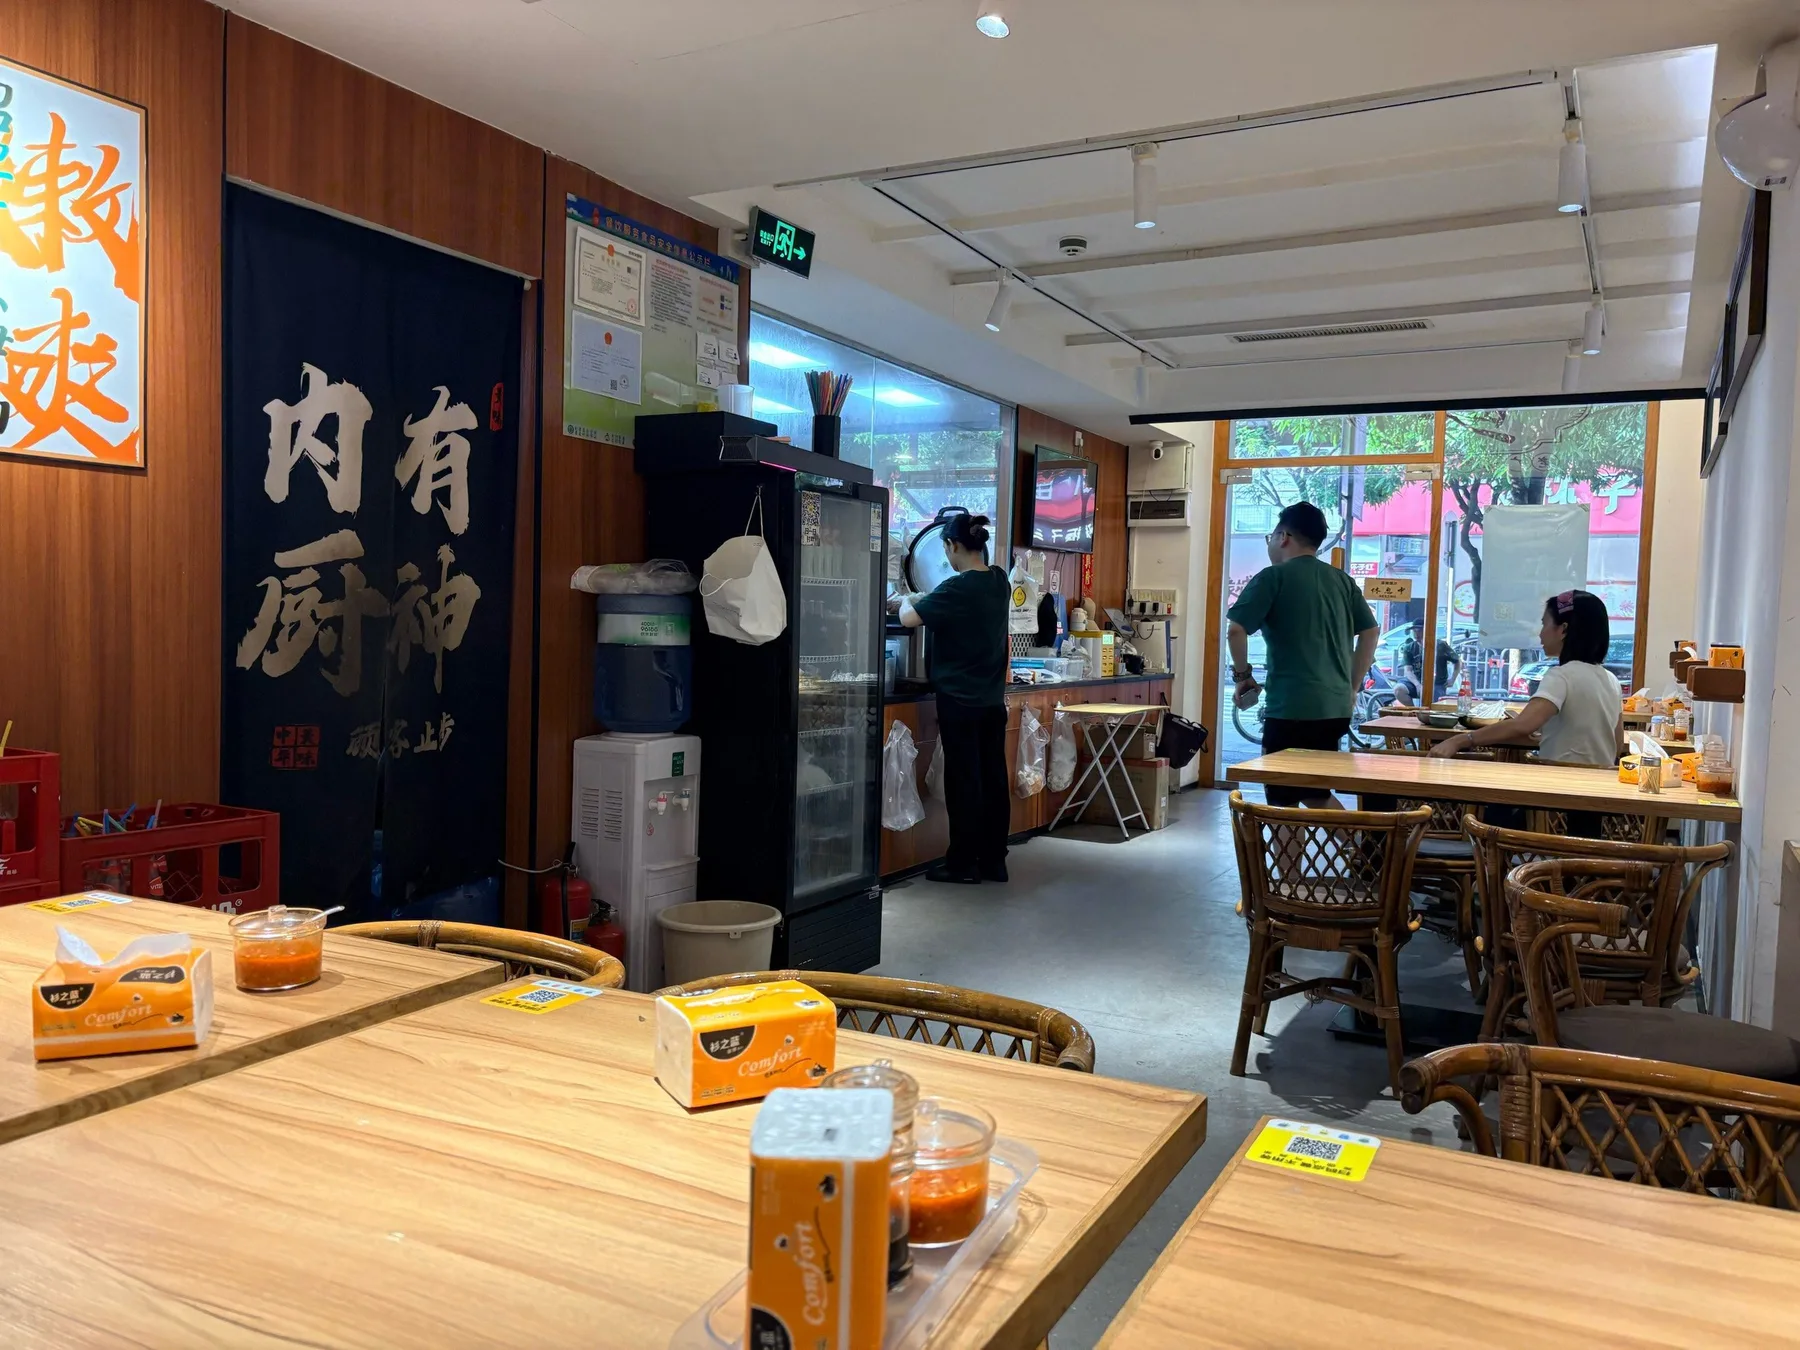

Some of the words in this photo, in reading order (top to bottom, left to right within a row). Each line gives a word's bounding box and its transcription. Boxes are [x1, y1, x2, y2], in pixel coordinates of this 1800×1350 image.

[760, 237, 772, 247] EXIT
[1370, 586, 1406, 595] 休息中
[84, 1004, 153, 1027] Comfort
[738, 1047, 804, 1077] Comfort
[793, 1221, 828, 1326] Comfort
